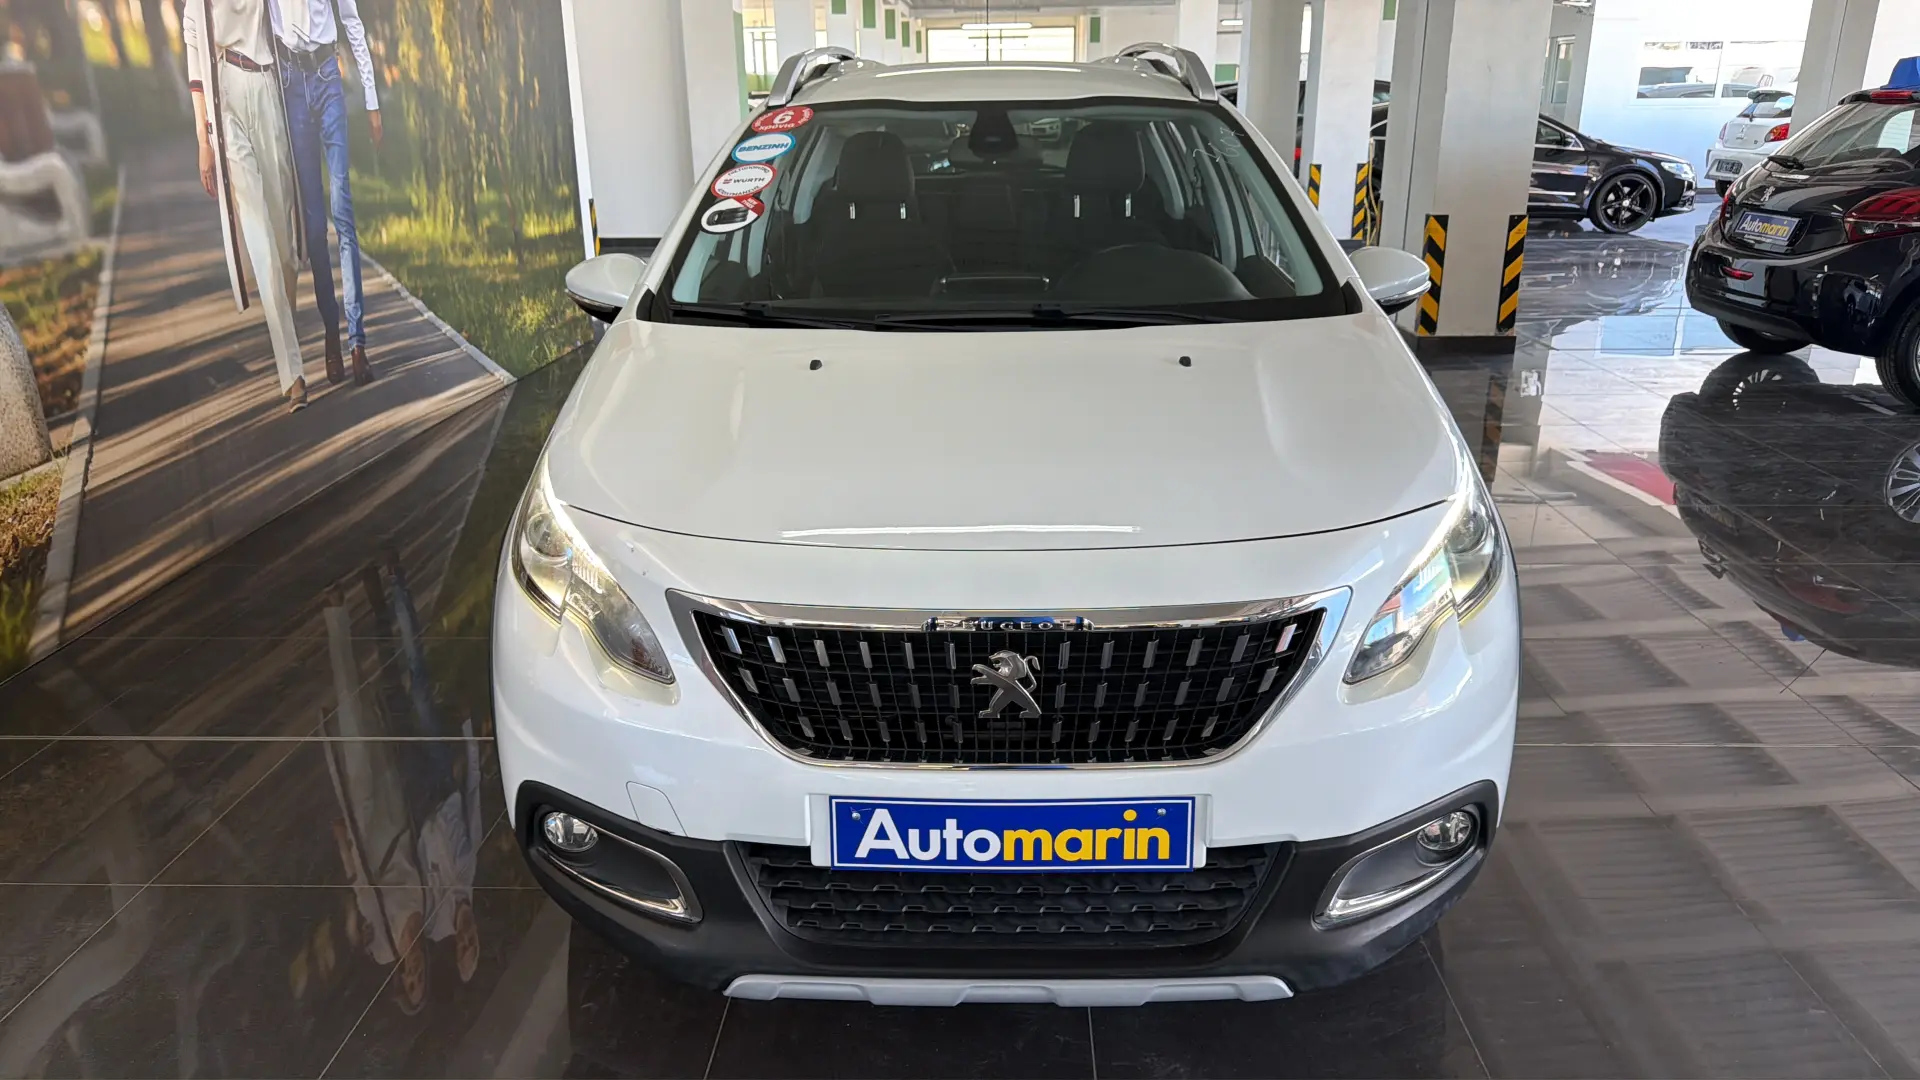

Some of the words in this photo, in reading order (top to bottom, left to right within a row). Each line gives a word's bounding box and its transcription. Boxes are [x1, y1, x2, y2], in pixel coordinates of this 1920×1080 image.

[773, 110, 794, 124] 6
[1739, 214, 1789, 237] Automarin
[854, 808, 1171, 862] Automarin
